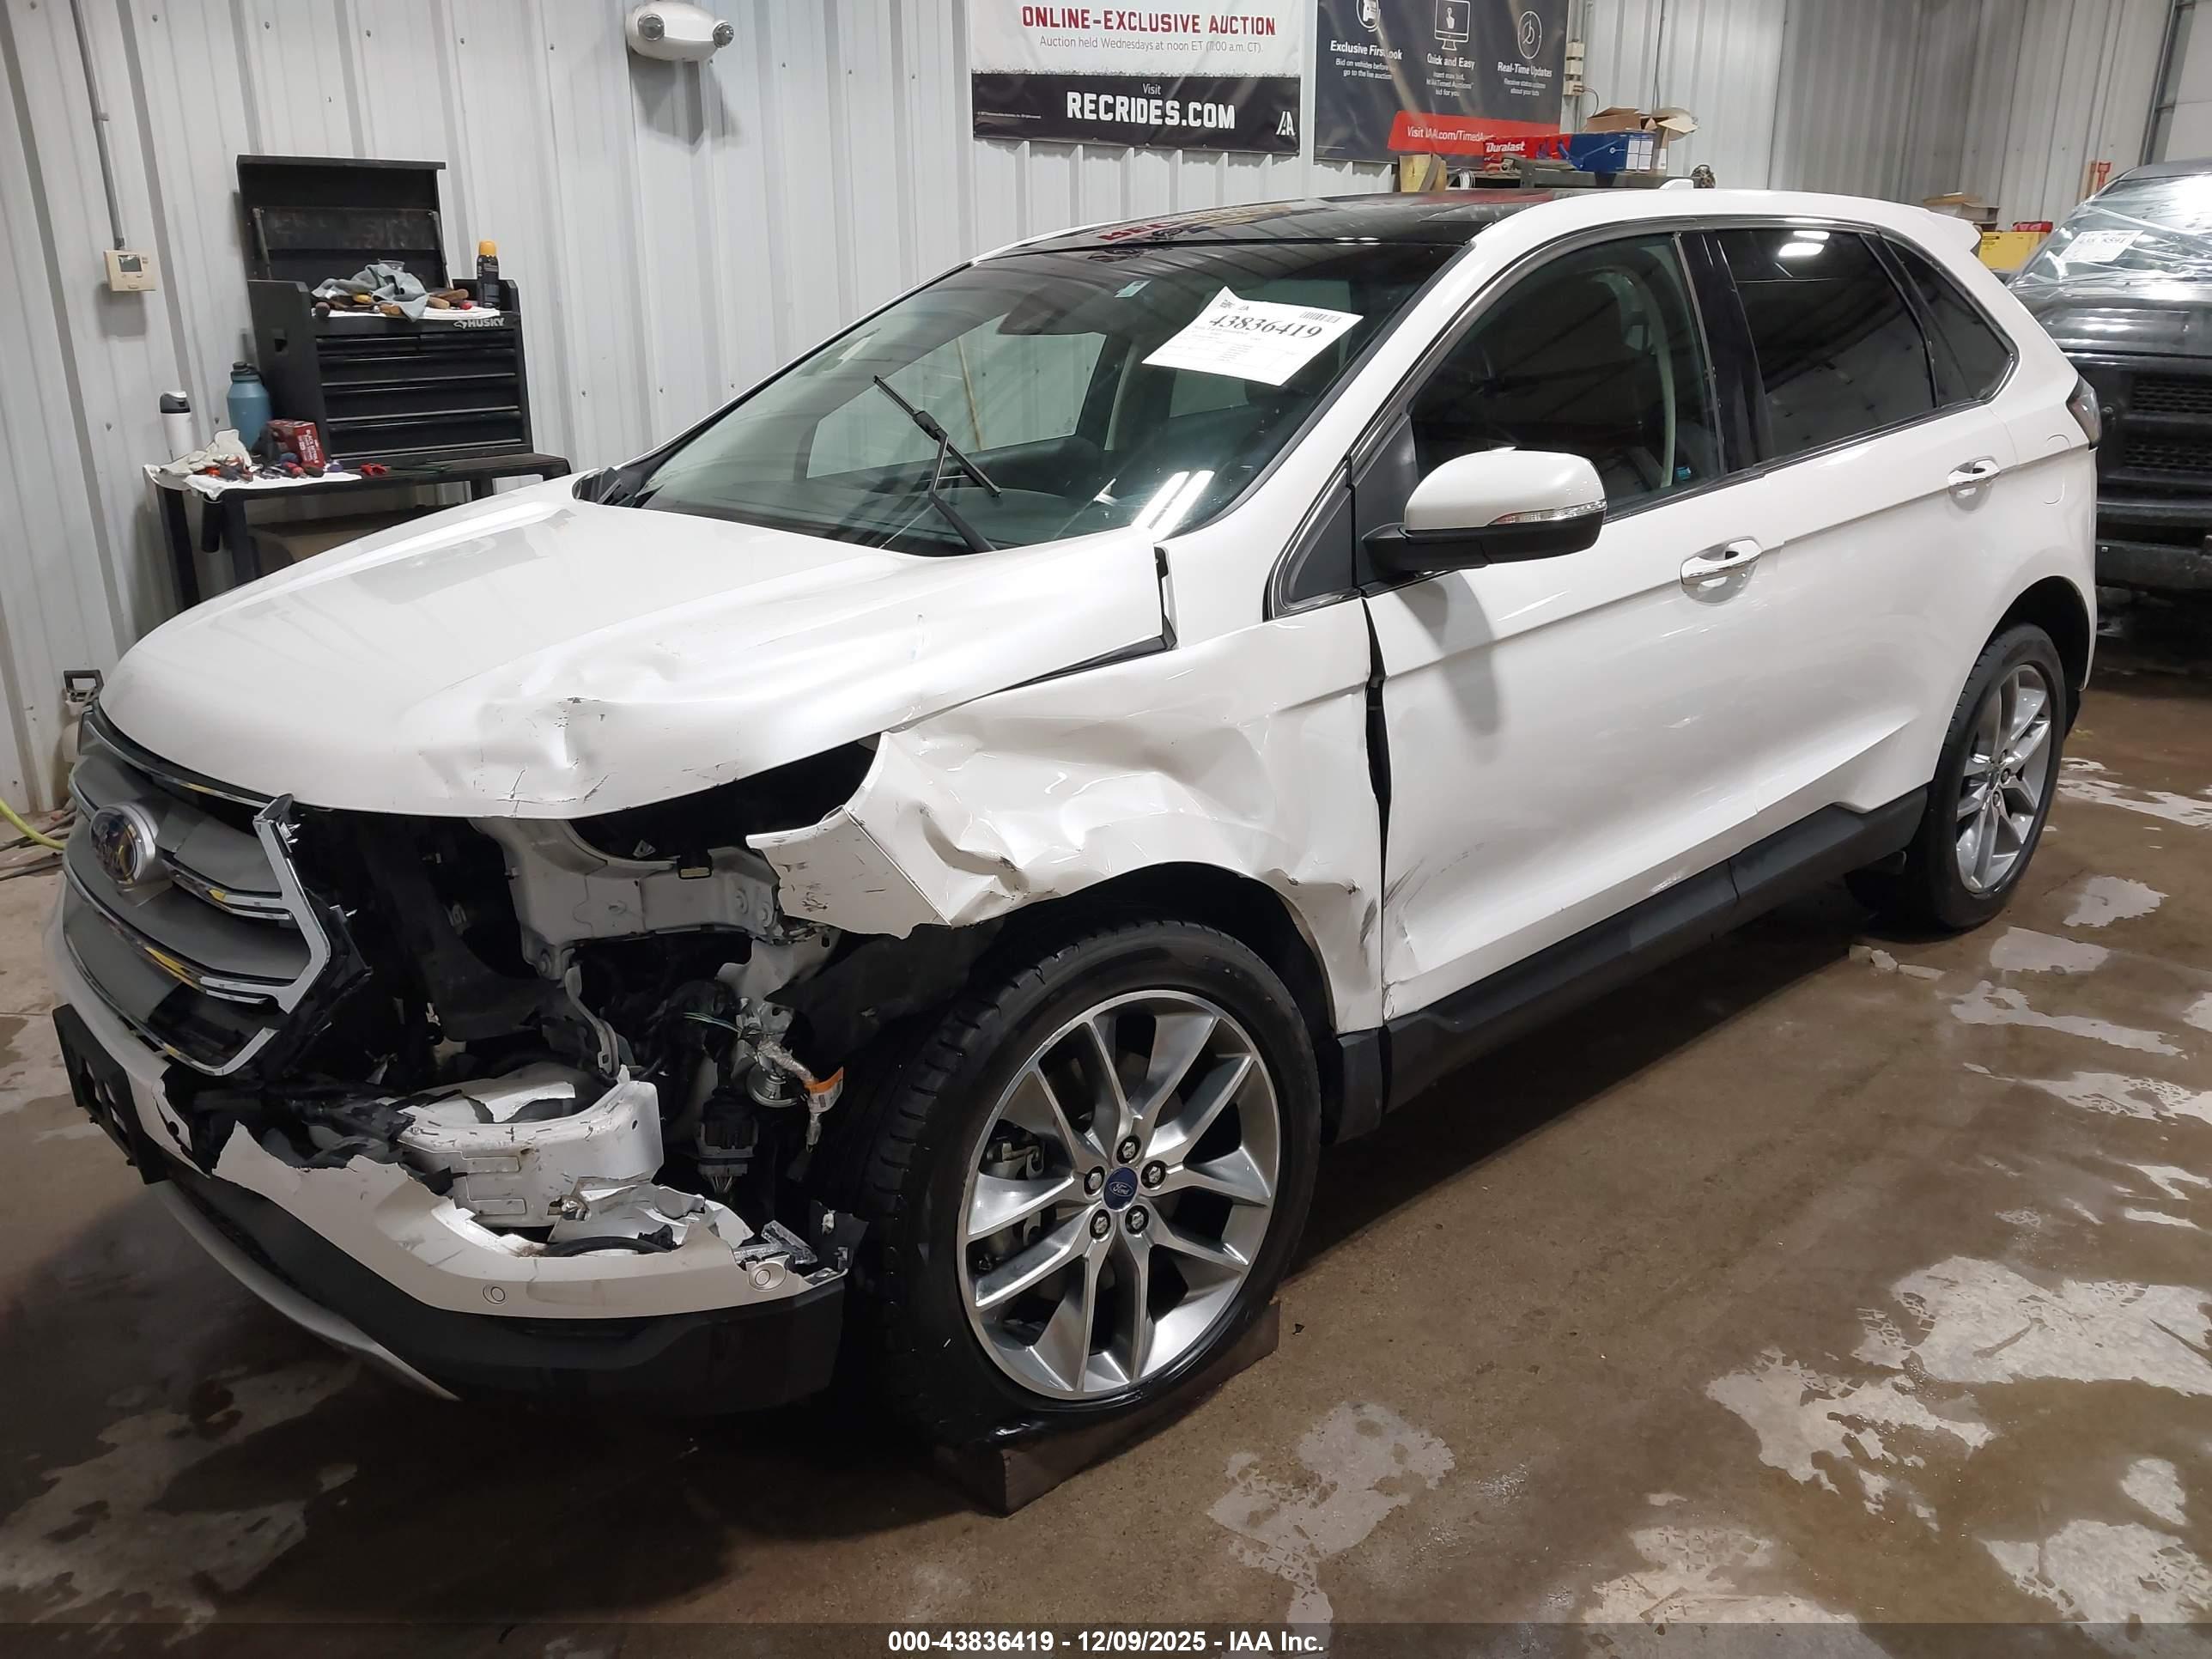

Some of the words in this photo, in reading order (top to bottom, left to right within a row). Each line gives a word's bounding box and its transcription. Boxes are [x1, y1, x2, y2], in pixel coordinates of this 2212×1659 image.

[1022, 6, 1201, 33] ONLINE-EXCLUSIVE
[1208, 15, 1276, 35] AUCTION
[1039, 35, 1076, 48] Auction
[1078, 36, 1098, 48] held
[1100, 37, 1154, 52] Wednesdays
[1155, 41, 1164, 51] at
[1167, 41, 1189, 51] noon
[1191, 41, 1204, 52] ET
[1330, 40, 1368, 55] Exclusive
[1426, 52, 1443, 65] Quick
[1443, 57, 1457, 67] and
[1458, 57, 1475, 70] Easy
[1498, 61, 1530, 75] Real-Time
[1530, 64, 1553, 78] Updates
[1143, 83, 1162, 95] Visit
[1066, 91, 1236, 130] RECRIDES.COM
[1407, 125, 1424, 137] Visit
[1486, 141, 1526, 153] Duralast
[467, 318, 505, 327] HUSKY
[1208, 314, 1323, 338] 43836419
